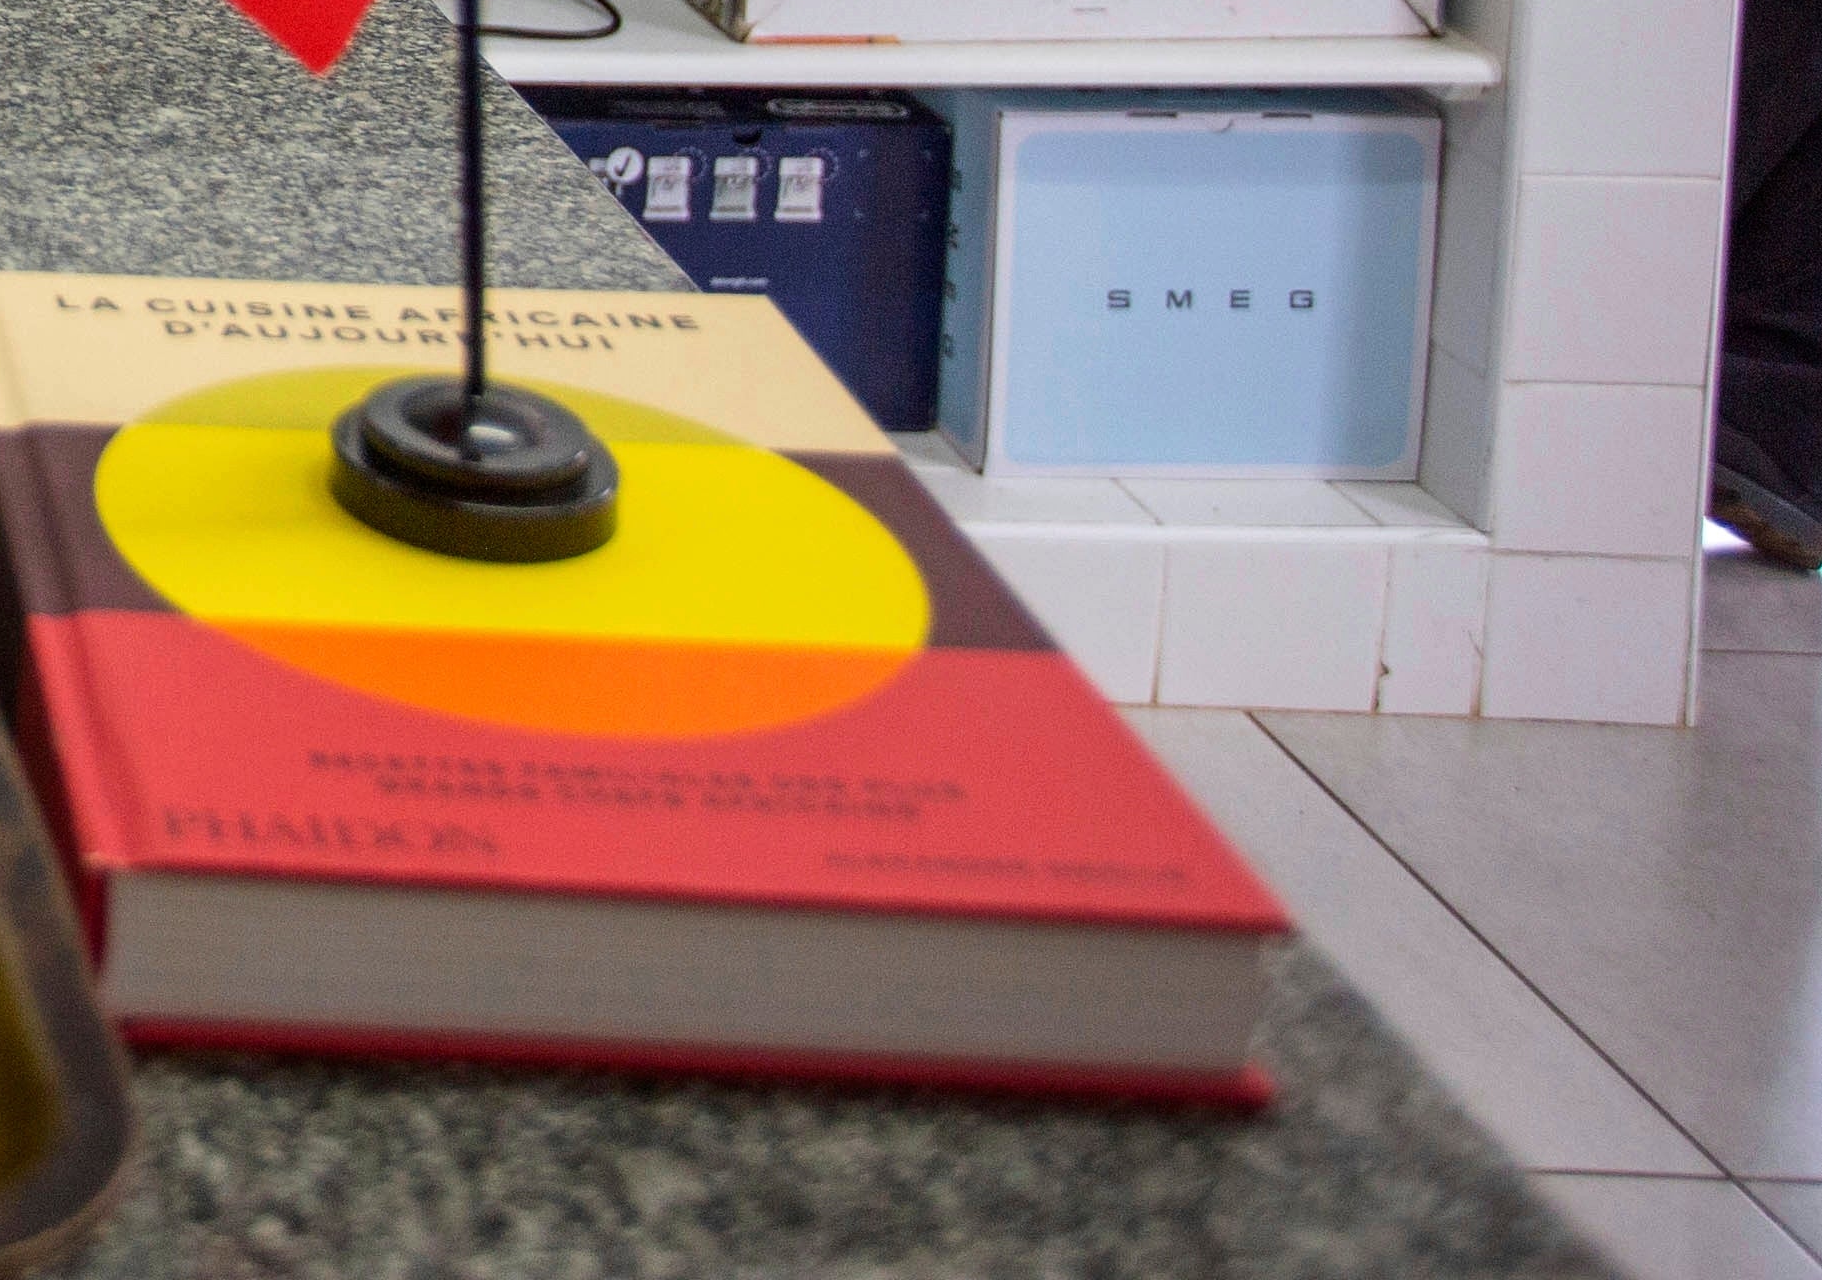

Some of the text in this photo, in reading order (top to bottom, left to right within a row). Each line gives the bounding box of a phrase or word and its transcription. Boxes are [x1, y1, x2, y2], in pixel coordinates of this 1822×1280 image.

[56, 293, 702, 332] LA CUISINE AFRICAINE
[1107, 289, 1315, 310] SMEG
